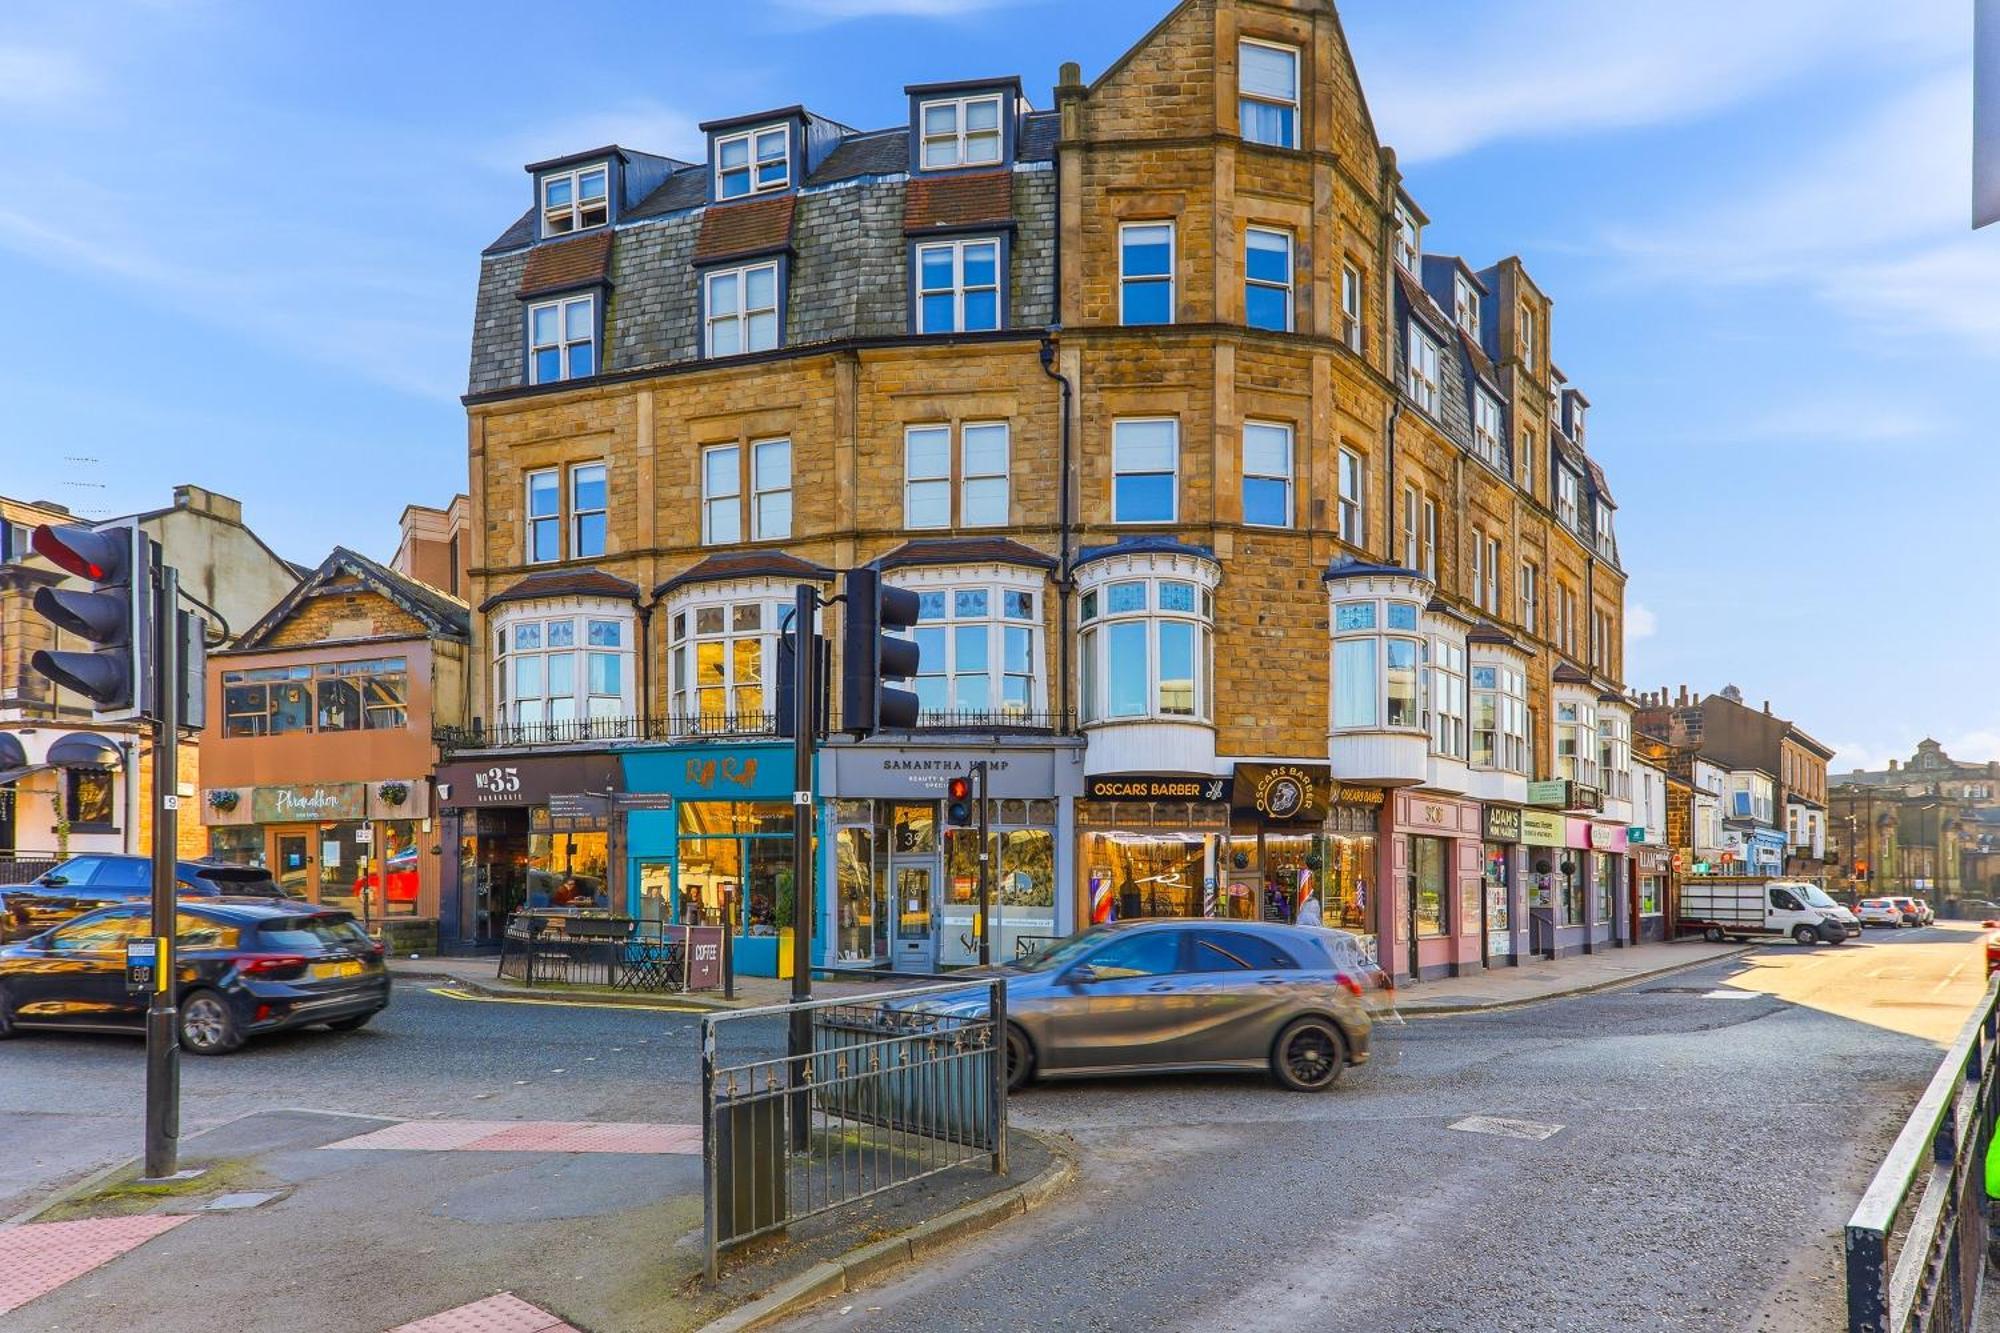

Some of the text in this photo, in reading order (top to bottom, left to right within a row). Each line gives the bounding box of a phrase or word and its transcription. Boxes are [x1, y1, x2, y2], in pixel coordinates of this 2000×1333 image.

[883, 760, 962, 770] SAMANTHA
[488, 767, 520, 792] 35
[1094, 783, 1200, 796] OSCARS BARBER
[1255, 766, 1286, 812] OSCARS
[695, 943, 717, 961] COFFEE
